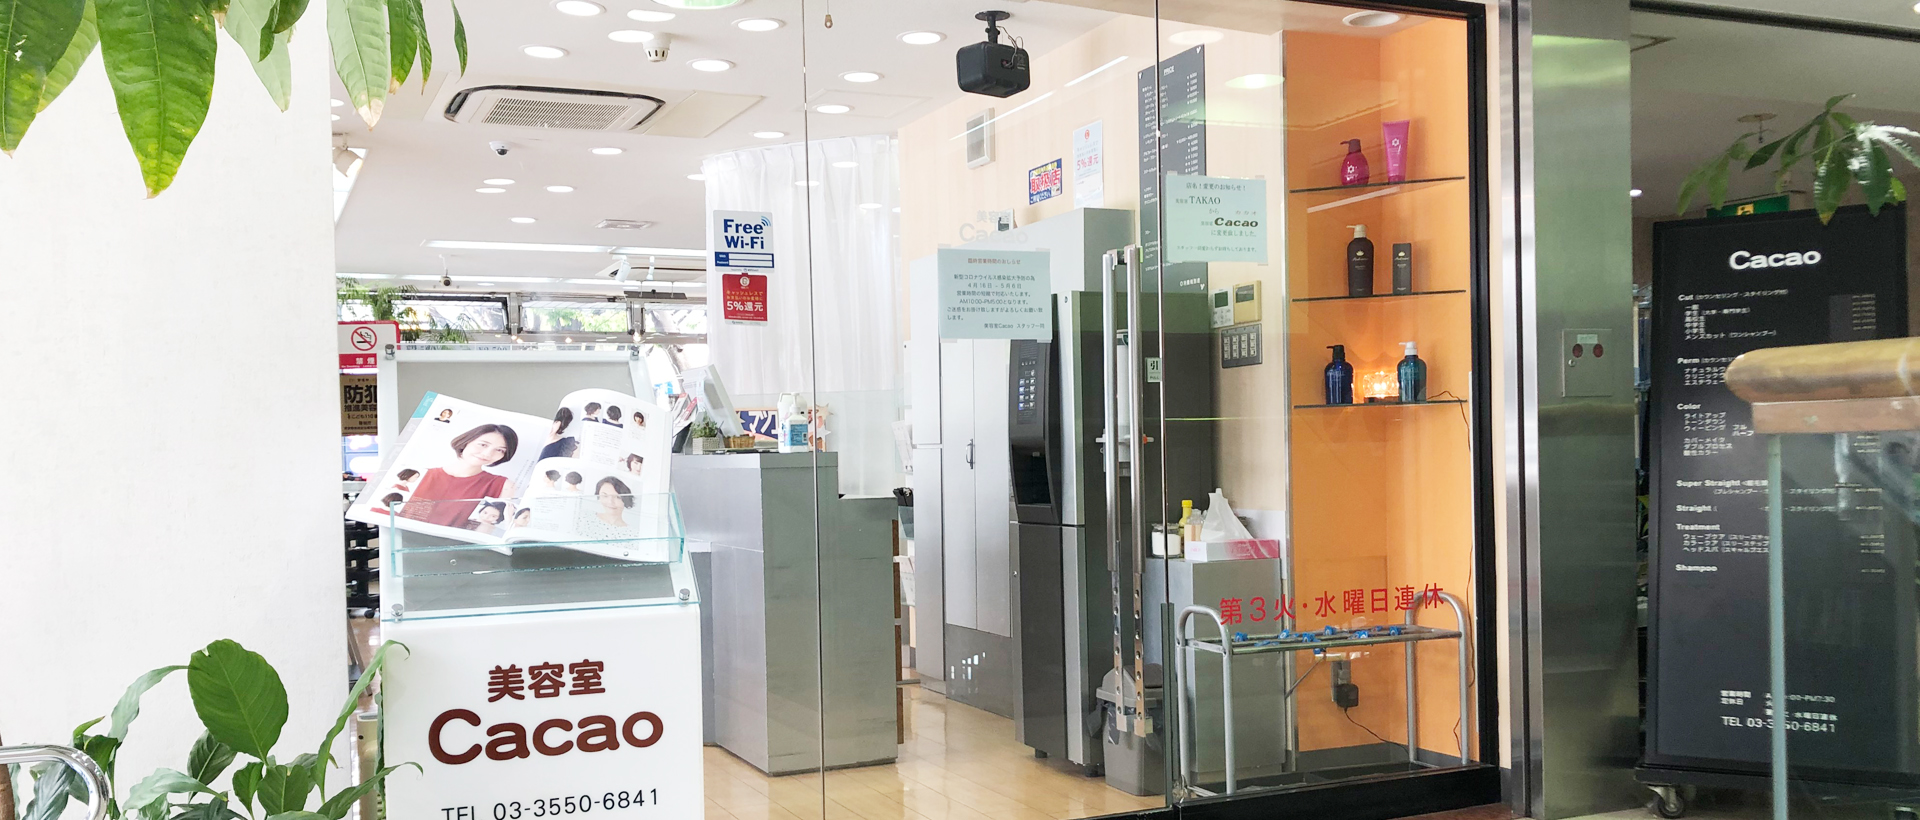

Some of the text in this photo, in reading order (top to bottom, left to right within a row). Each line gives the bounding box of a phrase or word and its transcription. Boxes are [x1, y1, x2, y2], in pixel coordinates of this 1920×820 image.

[1076, 154, 1099, 171] 5%還元
[1030, 168, 1061, 194] 取扱店
[1189, 196, 1221, 205] TAKAO
[723, 218, 764, 235] Free
[1214, 217, 1259, 227] Cacao
[959, 223, 1028, 244] Cacao
[724, 235, 765, 250] Wi-Fi
[1728, 250, 1822, 270] Cacao
[726, 301, 764, 312] 5%還元
[1150, 360, 1158, 370] 引
[1676, 504, 1712, 513] Straight
[1675, 564, 1718, 572] Shampoo
[1219, 582, 1445, 626] 第3火・水曜日連休
[487, 658, 606, 703] 美容室
[1720, 697, 1743, 705] 定休日
[1720, 716, 1836, 733] TEL 03-350-6841
[428, 708, 664, 765] Cacao
[493, 788, 658, 820] 03-3550-6841
